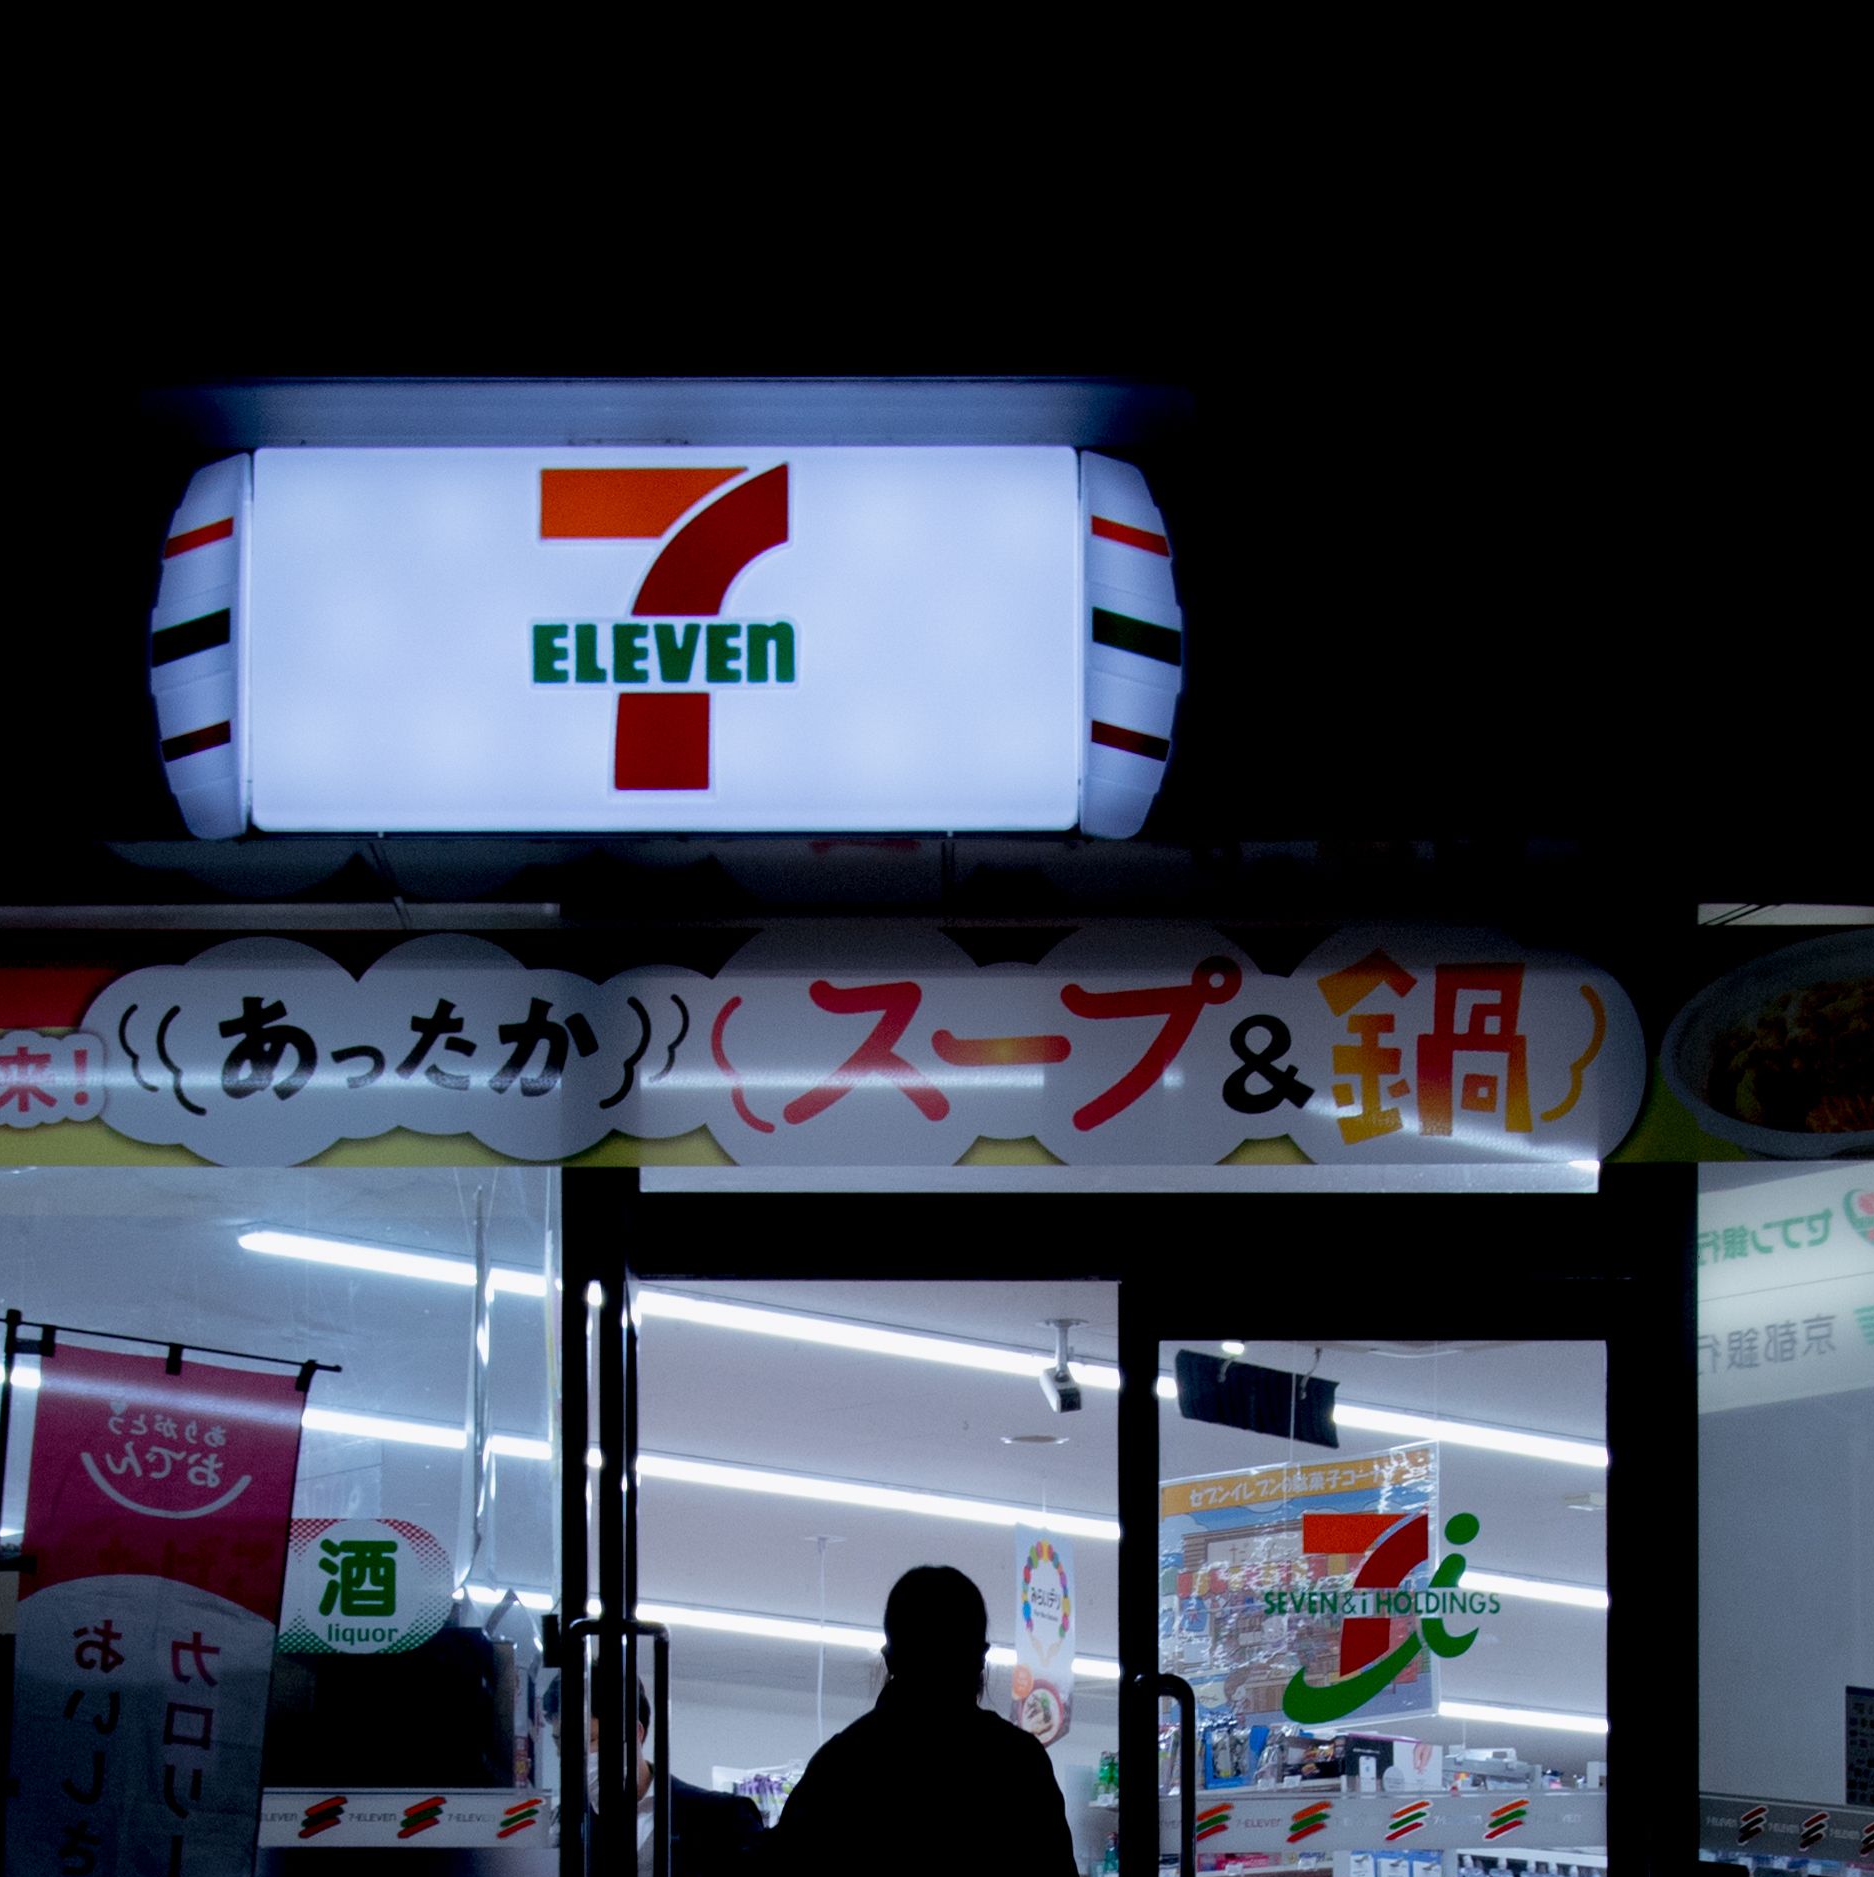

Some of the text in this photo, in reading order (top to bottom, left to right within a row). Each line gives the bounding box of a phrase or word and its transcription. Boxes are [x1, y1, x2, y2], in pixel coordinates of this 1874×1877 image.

[539, 461, 789, 790] 7
[220, 996, 596, 1101] あったか
[318, 1538, 398, 1617] 酒
[1376, 1590, 1502, 1615] HOLDINGS
[327, 1623, 399, 1646] liquor
